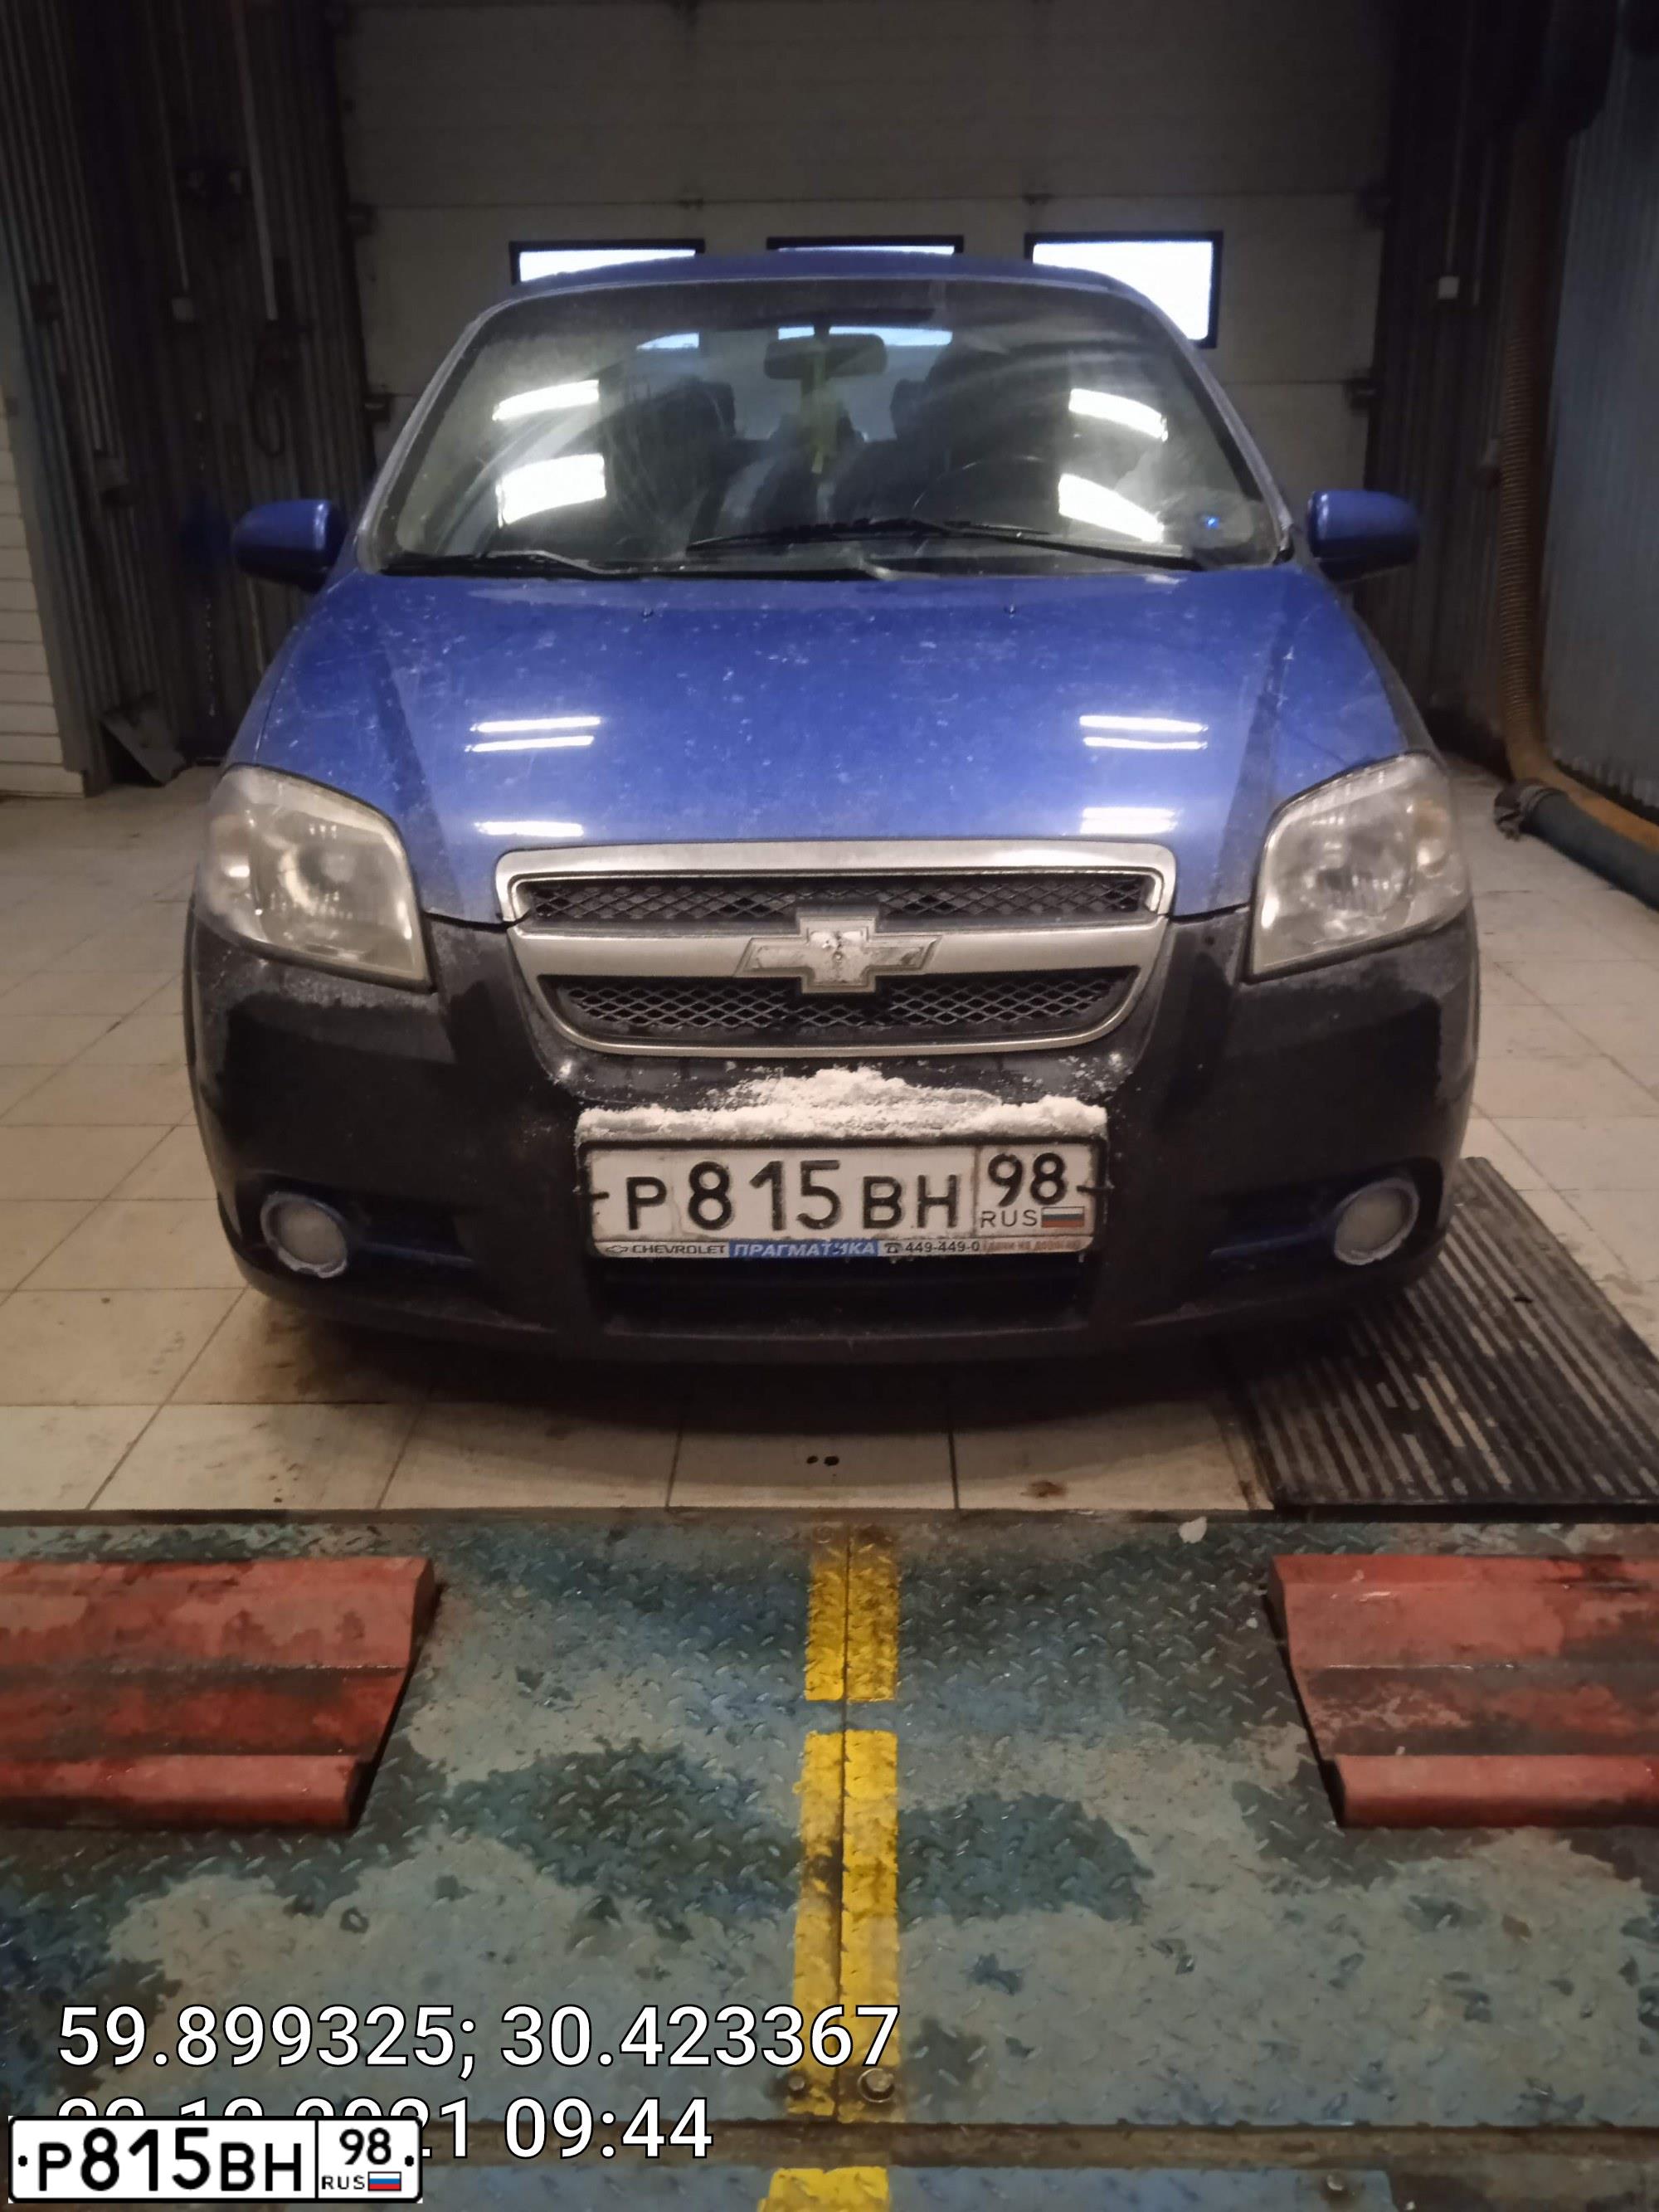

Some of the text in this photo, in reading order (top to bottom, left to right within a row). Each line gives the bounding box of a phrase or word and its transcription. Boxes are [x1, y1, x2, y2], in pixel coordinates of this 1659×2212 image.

[987, 1152, 1067, 1207] 98
[980, 1209, 1038, 1229] RUS
[631, 1244, 725, 1255] CHEVROLET
